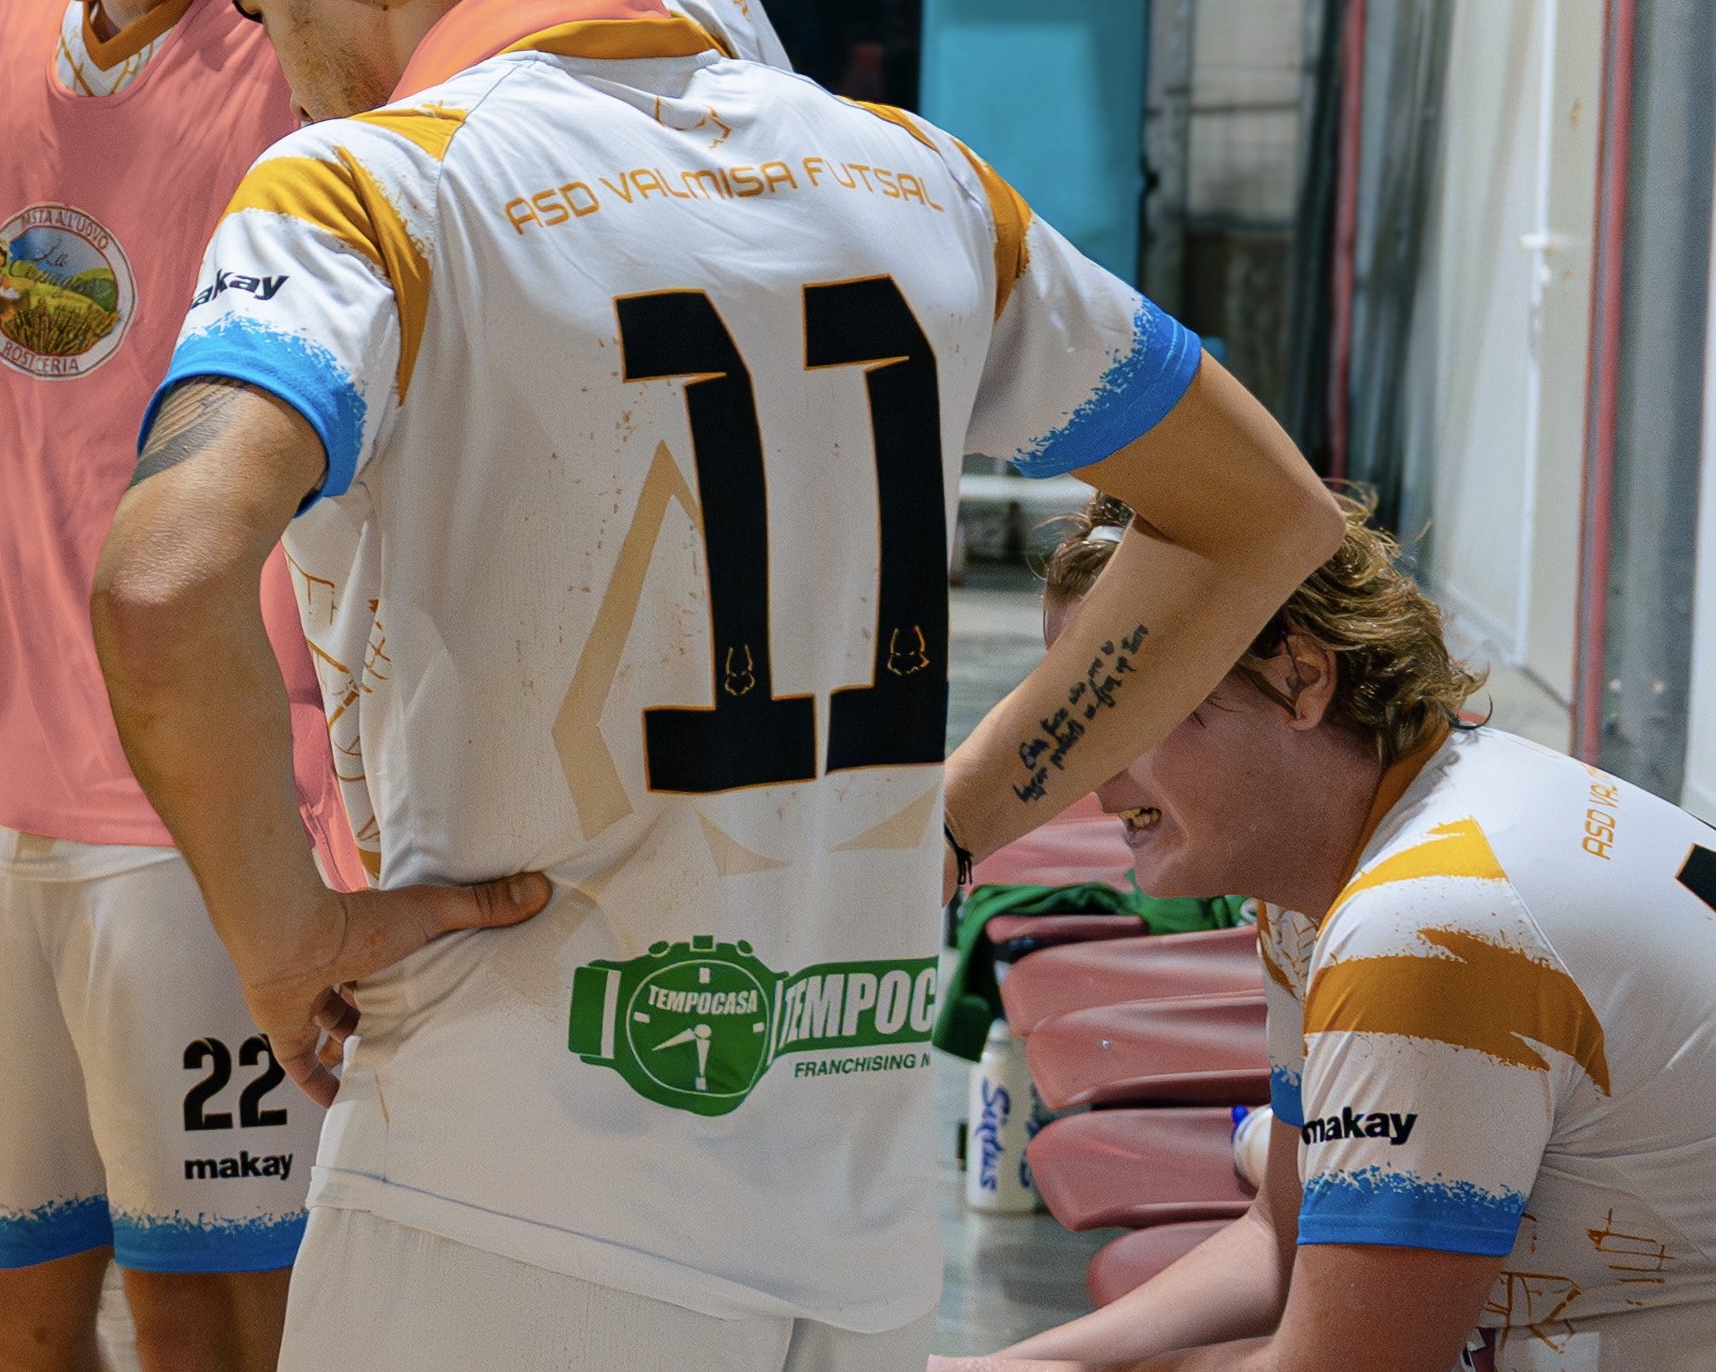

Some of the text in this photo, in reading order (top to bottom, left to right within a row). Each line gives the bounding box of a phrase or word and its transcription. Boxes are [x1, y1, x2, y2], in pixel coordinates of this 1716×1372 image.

[504, 156, 944, 235] ASD VALMISA FUTSAL
[189, 268, 290, 310] akay
[614, 274, 950, 793] 11
[1581, 808, 1617, 861] ASD
[648, 984, 759, 1015] TEMPOCASA
[183, 1033, 288, 1132] 22
[794, 1053, 916, 1078] FRANCHISING
[1301, 1106, 1418, 1146] makay
[184, 1149, 294, 1181] makay
